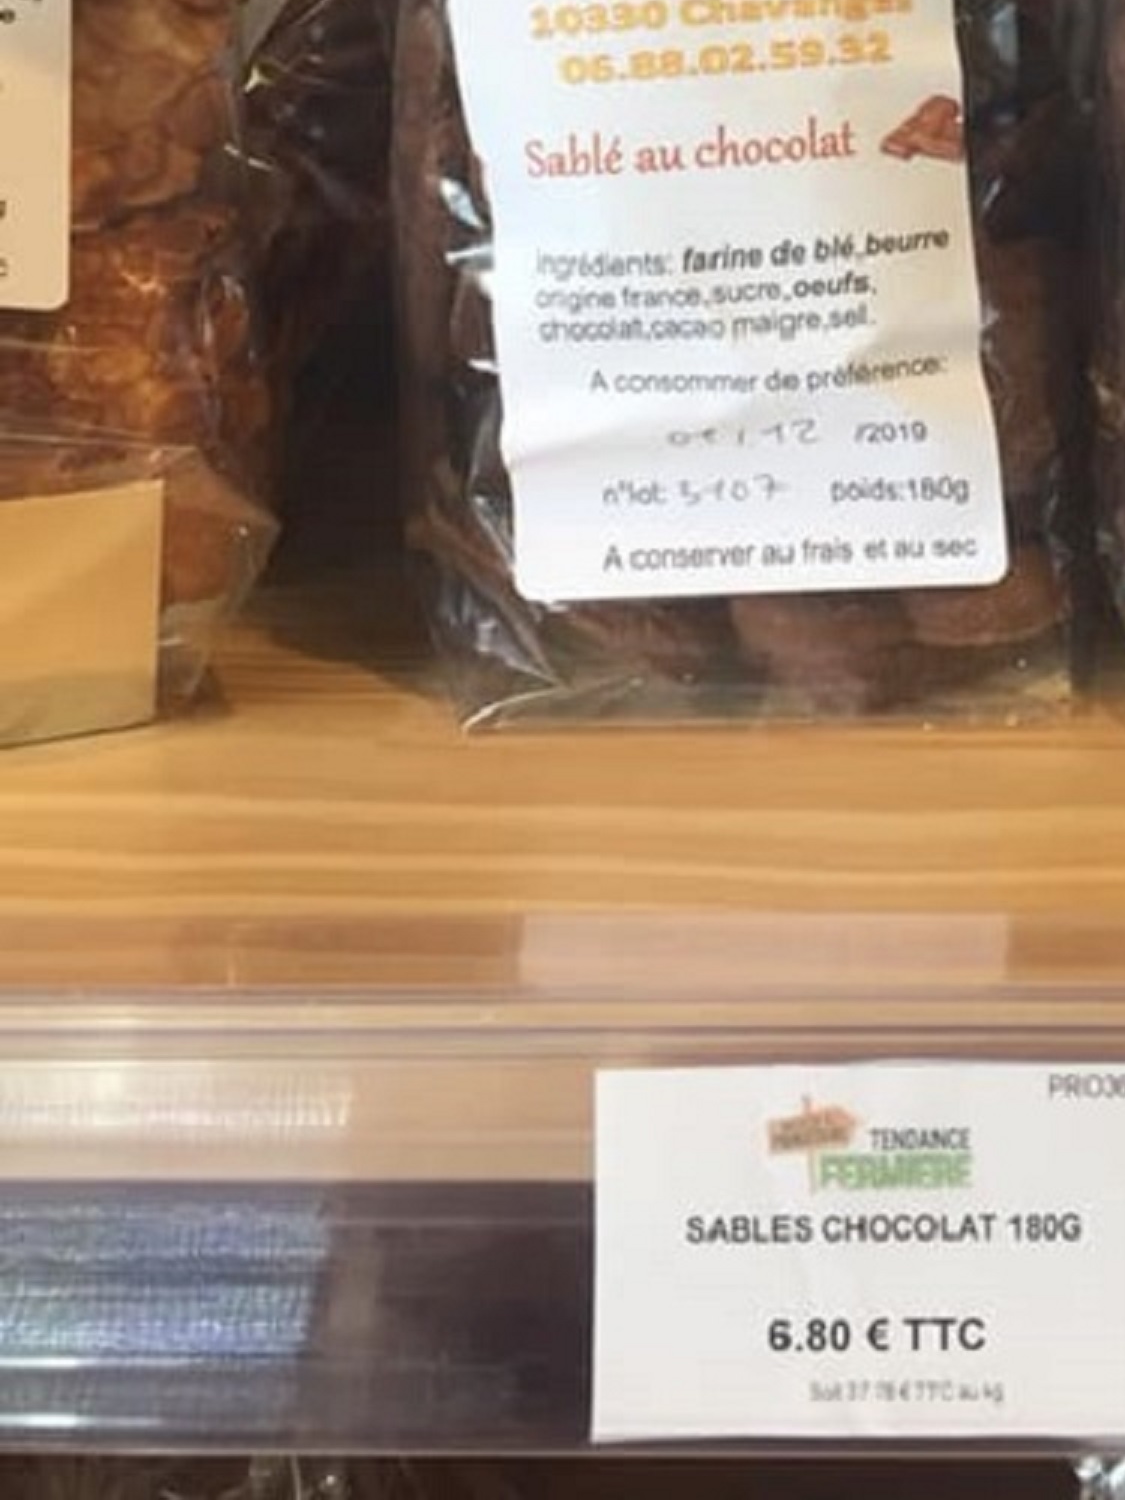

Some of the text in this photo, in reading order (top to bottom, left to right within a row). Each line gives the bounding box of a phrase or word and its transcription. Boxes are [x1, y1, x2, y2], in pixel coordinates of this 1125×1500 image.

[530, 2, 667, 39] 10330
[560, 31, 892, 86] 06.88.02.59.32
[524, 116, 856, 180] Sablé au chocolat
[682, 243, 763, 273] farine
[770, 238, 806, 265] de
[535, 287, 617, 314] origine
[590, 355, 947, 394] A consommer de préférence:
[603, 535, 978, 571] A conserver au frais et au sec
[869, 1126, 971, 1151] TENDANCE
[685, 1212, 1082, 1245] SABLES CHOCOLAT 180G
[768, 1317, 986, 1353] 6.80 € TTC
